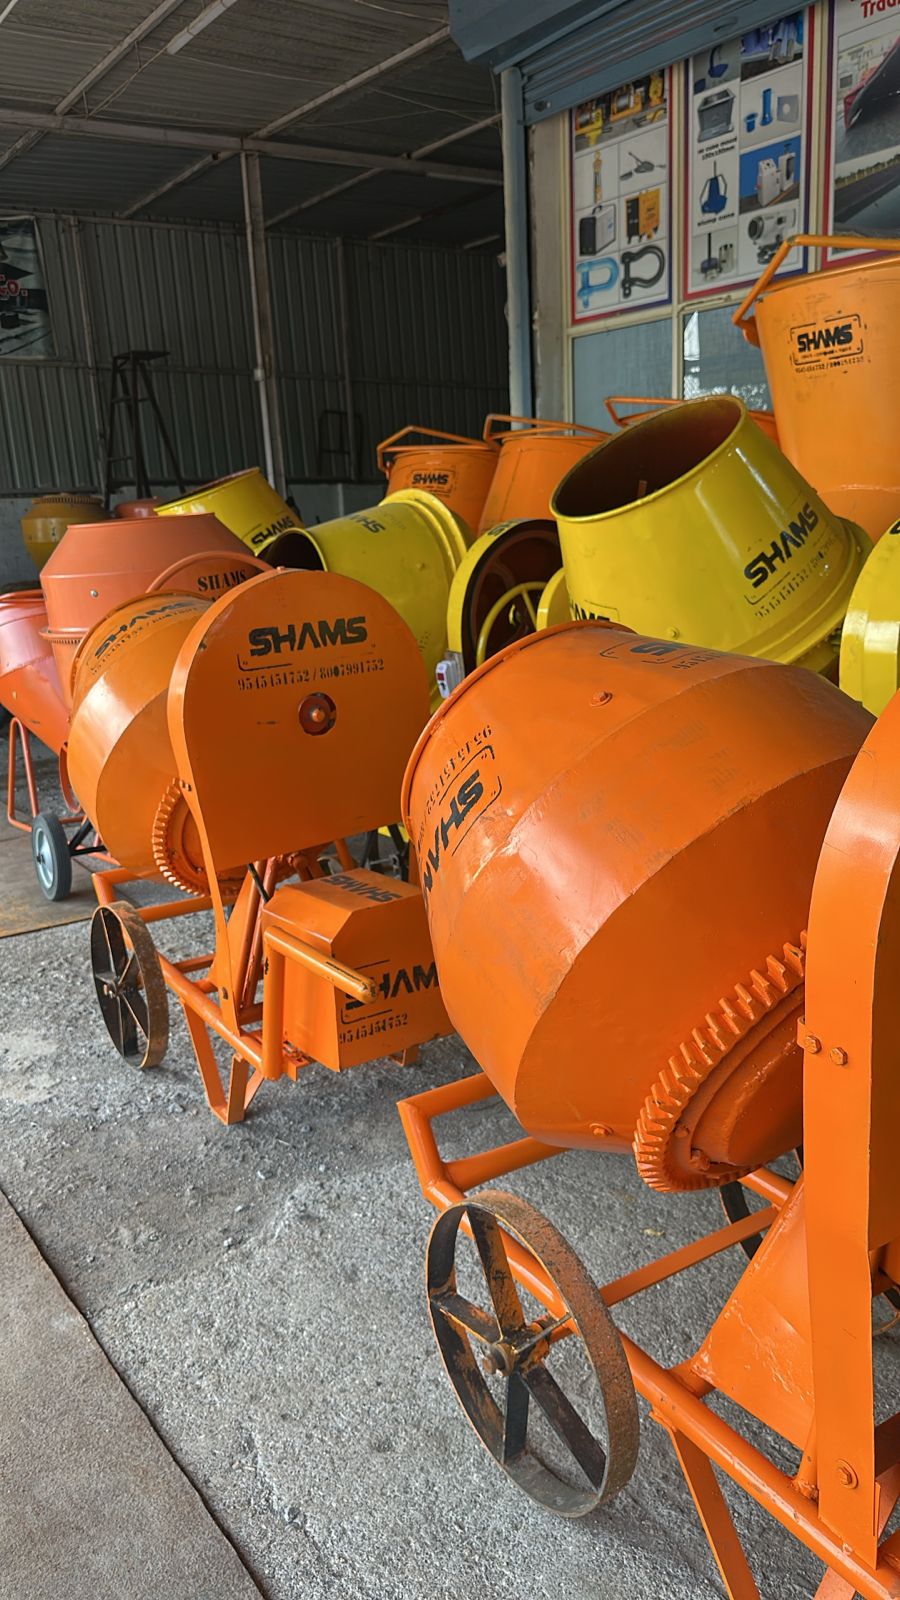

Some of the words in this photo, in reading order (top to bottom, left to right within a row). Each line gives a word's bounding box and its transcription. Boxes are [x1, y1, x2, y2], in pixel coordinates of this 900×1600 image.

[797, 324, 853, 353] SHAMS
[412, 473, 449, 485] SHAMS
[744, 502, 819, 588] SHAMS
[249, 616, 368, 657] SHAMS
[322, 875, 402, 902] SHAMS
